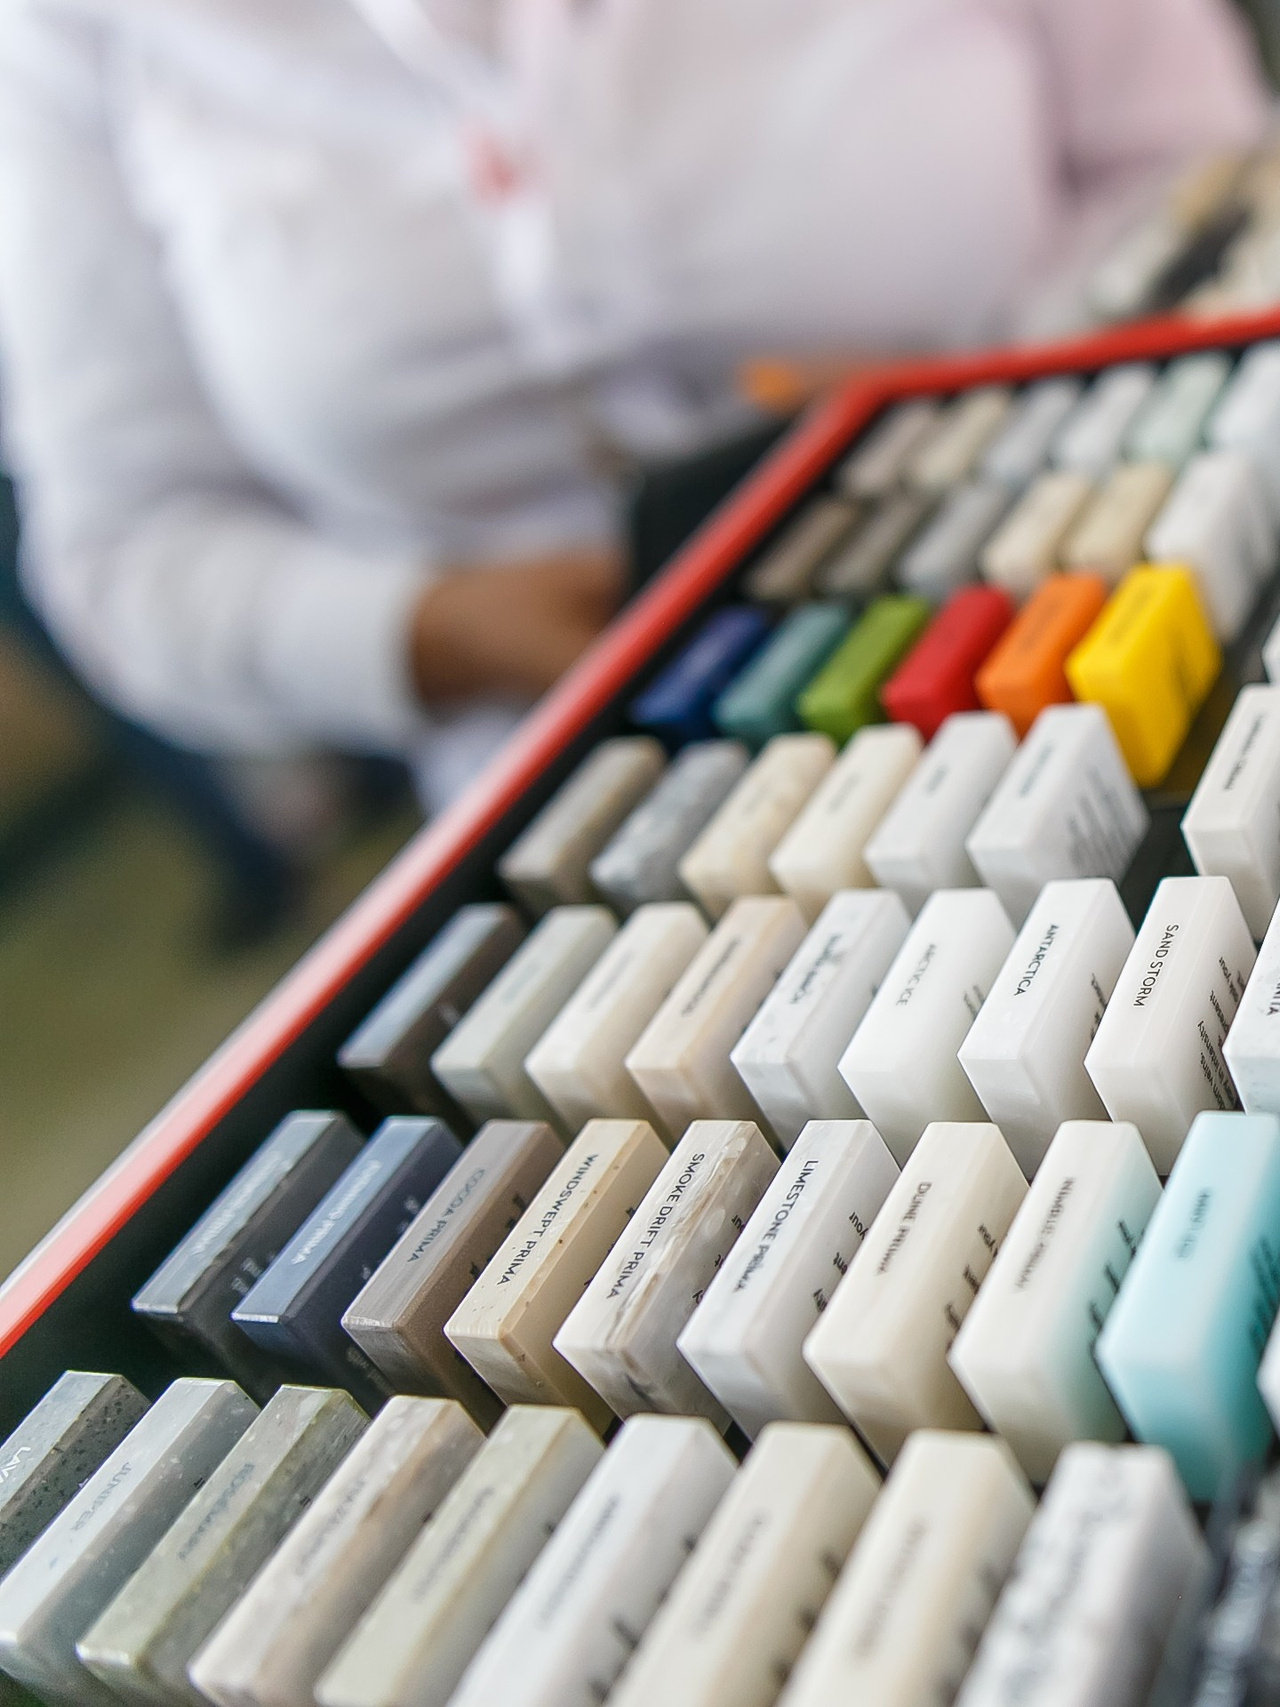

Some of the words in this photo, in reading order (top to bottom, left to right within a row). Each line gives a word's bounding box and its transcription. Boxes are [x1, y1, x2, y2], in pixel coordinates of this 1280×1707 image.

[1013, 923, 1059, 997] ANTARCTICA
[1152, 923, 1180, 963] SAND
[1132, 963, 1164, 1008] STORM
[1218, 956, 1233, 984] your
[1198, 1020, 1219, 1069] intensity
[533, 1154, 599, 1238] WINDSWEPT
[666, 1153, 705, 1202] SMOKE
[762, 1160, 819, 1241] LIMESTONE
[903, 1181, 933, 1221] DUNE
[407, 1219, 448, 1263] PRIMA
[640, 1206, 673, 1248] DRIFT
[849, 1211, 870, 1240] your
[497, 1240, 537, 1285] PRIMA
[606, 1251, 645, 1299] PRIMA
[732, 1244, 770, 1293] PRIMA
[0, 1446, 31, 1484] LAV
